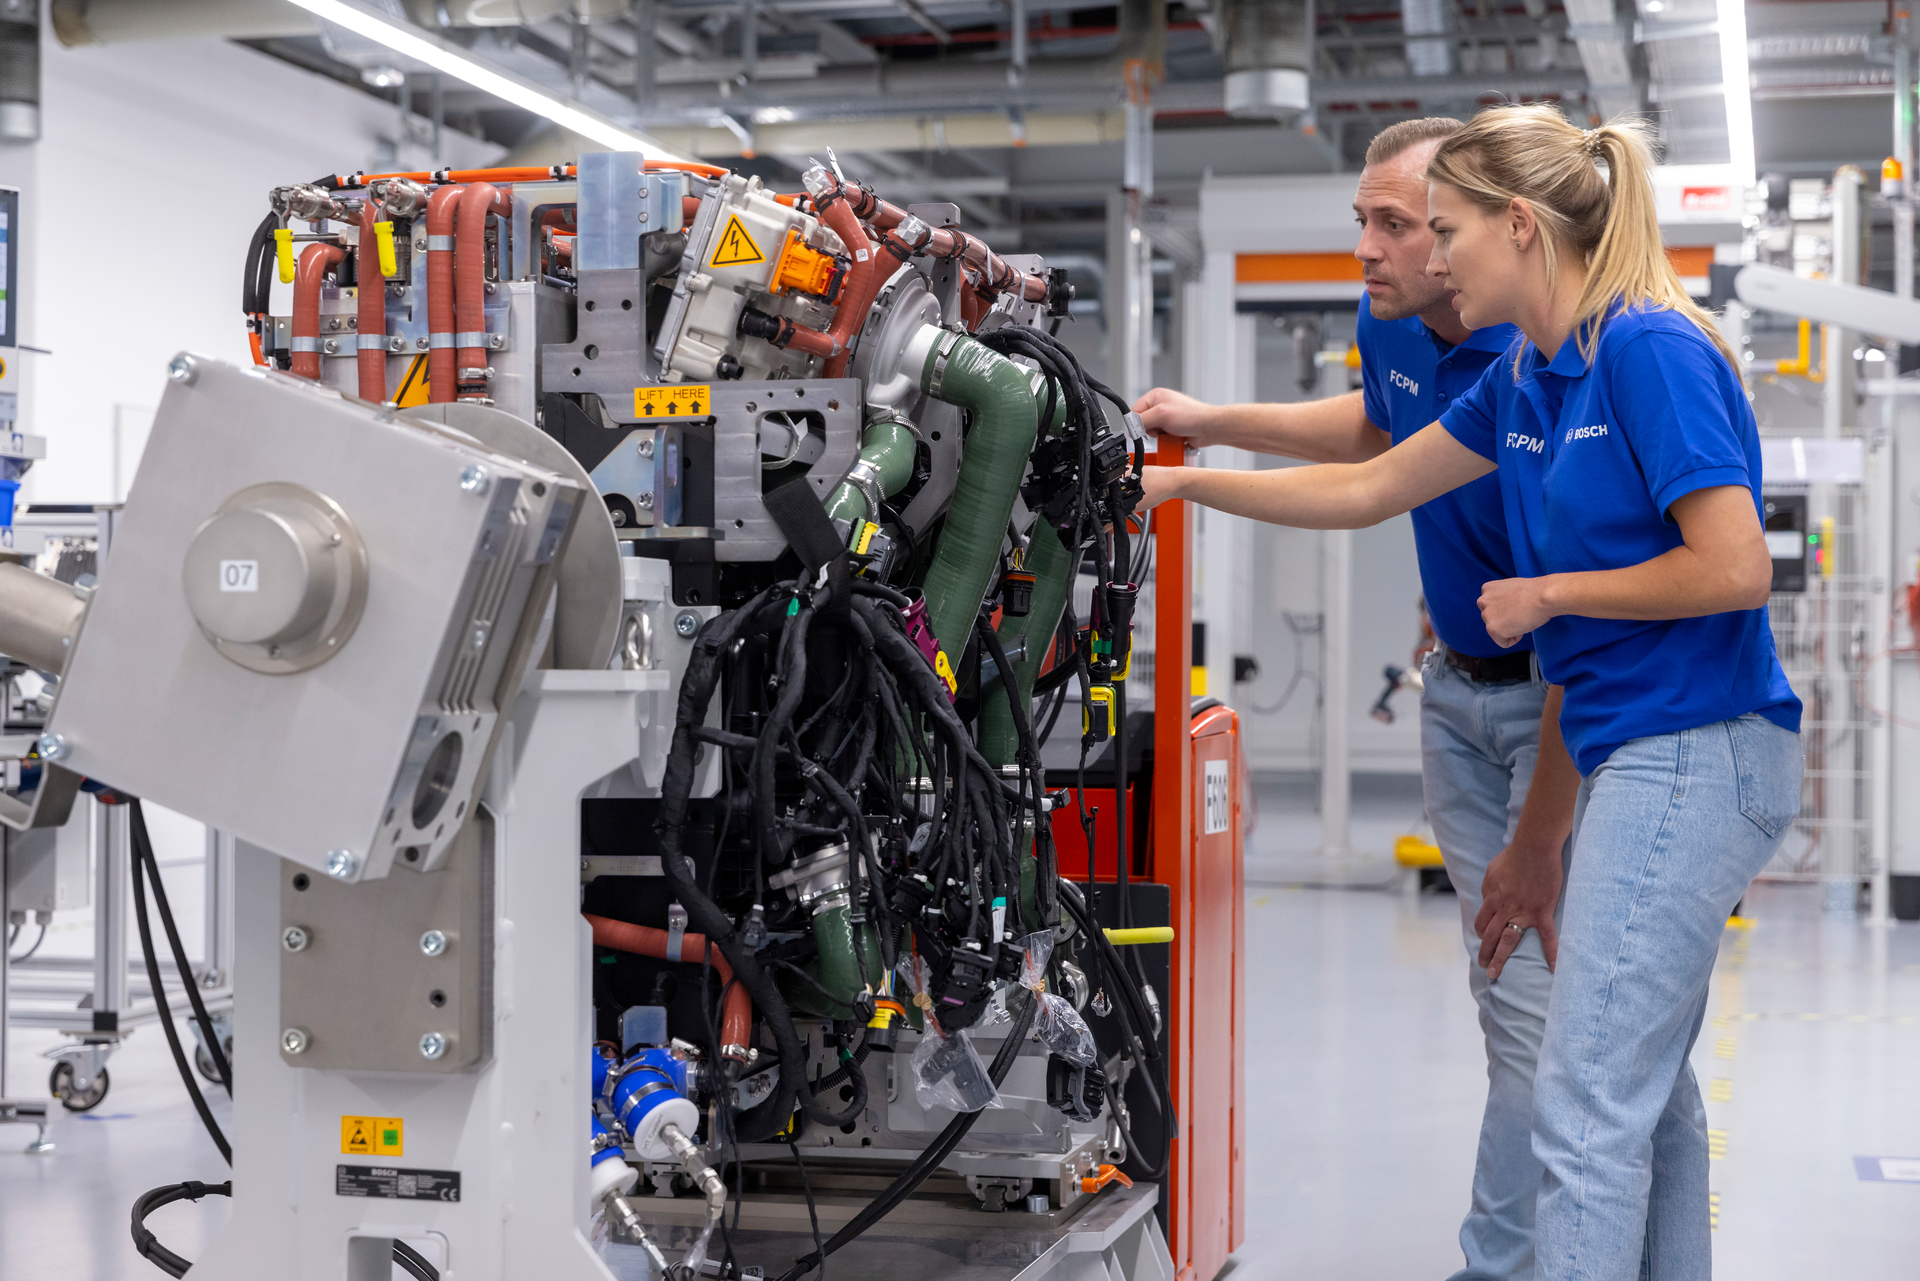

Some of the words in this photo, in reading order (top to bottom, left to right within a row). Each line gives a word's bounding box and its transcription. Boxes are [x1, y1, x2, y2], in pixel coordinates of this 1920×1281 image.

[1389, 369, 1419, 397] FCPM
[638, 389, 665, 401] LIFT
[673, 388, 706, 399] HERE
[1574, 424, 1608, 441] BOSCH
[1506, 432, 1545, 454] FCPM
[224, 564, 254, 587] 07
[371, 1168, 398, 1177] BOSCH
